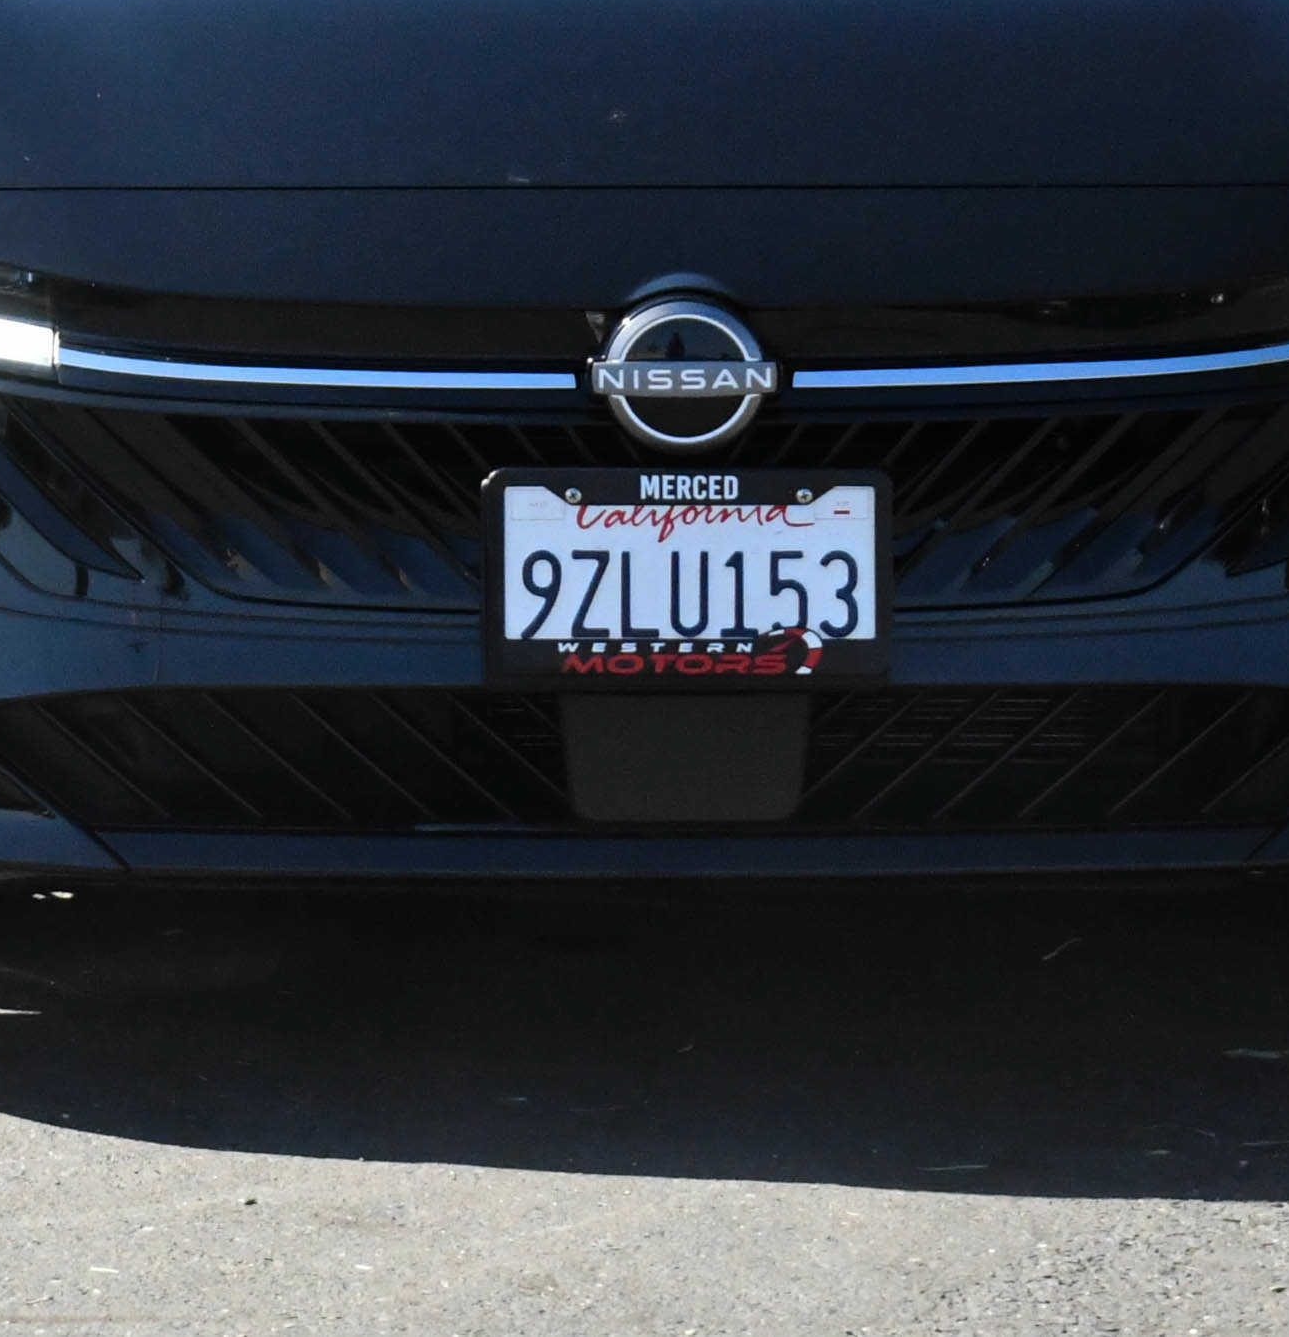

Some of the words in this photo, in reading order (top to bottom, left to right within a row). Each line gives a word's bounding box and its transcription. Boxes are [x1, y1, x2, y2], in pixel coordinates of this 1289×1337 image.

[598, 367, 773, 391] NISSAN
[639, 475, 739, 500] MERCED
[521, 550, 859, 639] 9ZLU153
[557, 642, 753, 653] WESTERN
[563, 653, 787, 675] MOTORS
